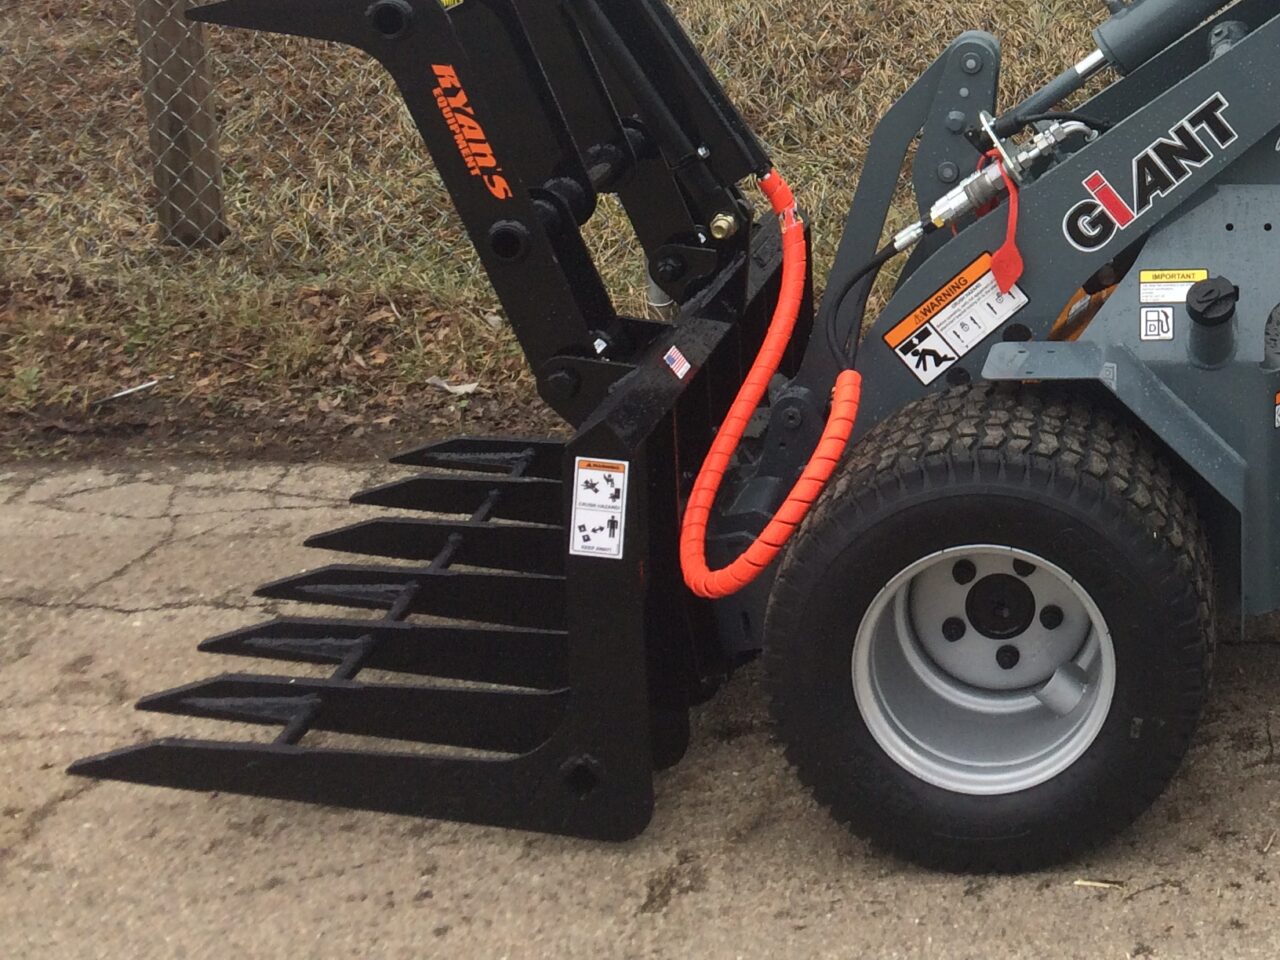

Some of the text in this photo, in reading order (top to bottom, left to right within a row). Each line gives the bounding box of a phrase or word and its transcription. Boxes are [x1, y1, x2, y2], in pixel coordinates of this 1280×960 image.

[432, 86, 481, 176] EQUIPMENT
[1151, 272, 1196, 280] IMPORTANT
[919, 276, 969, 317] WARNING
[1149, 323, 1157, 332] D
